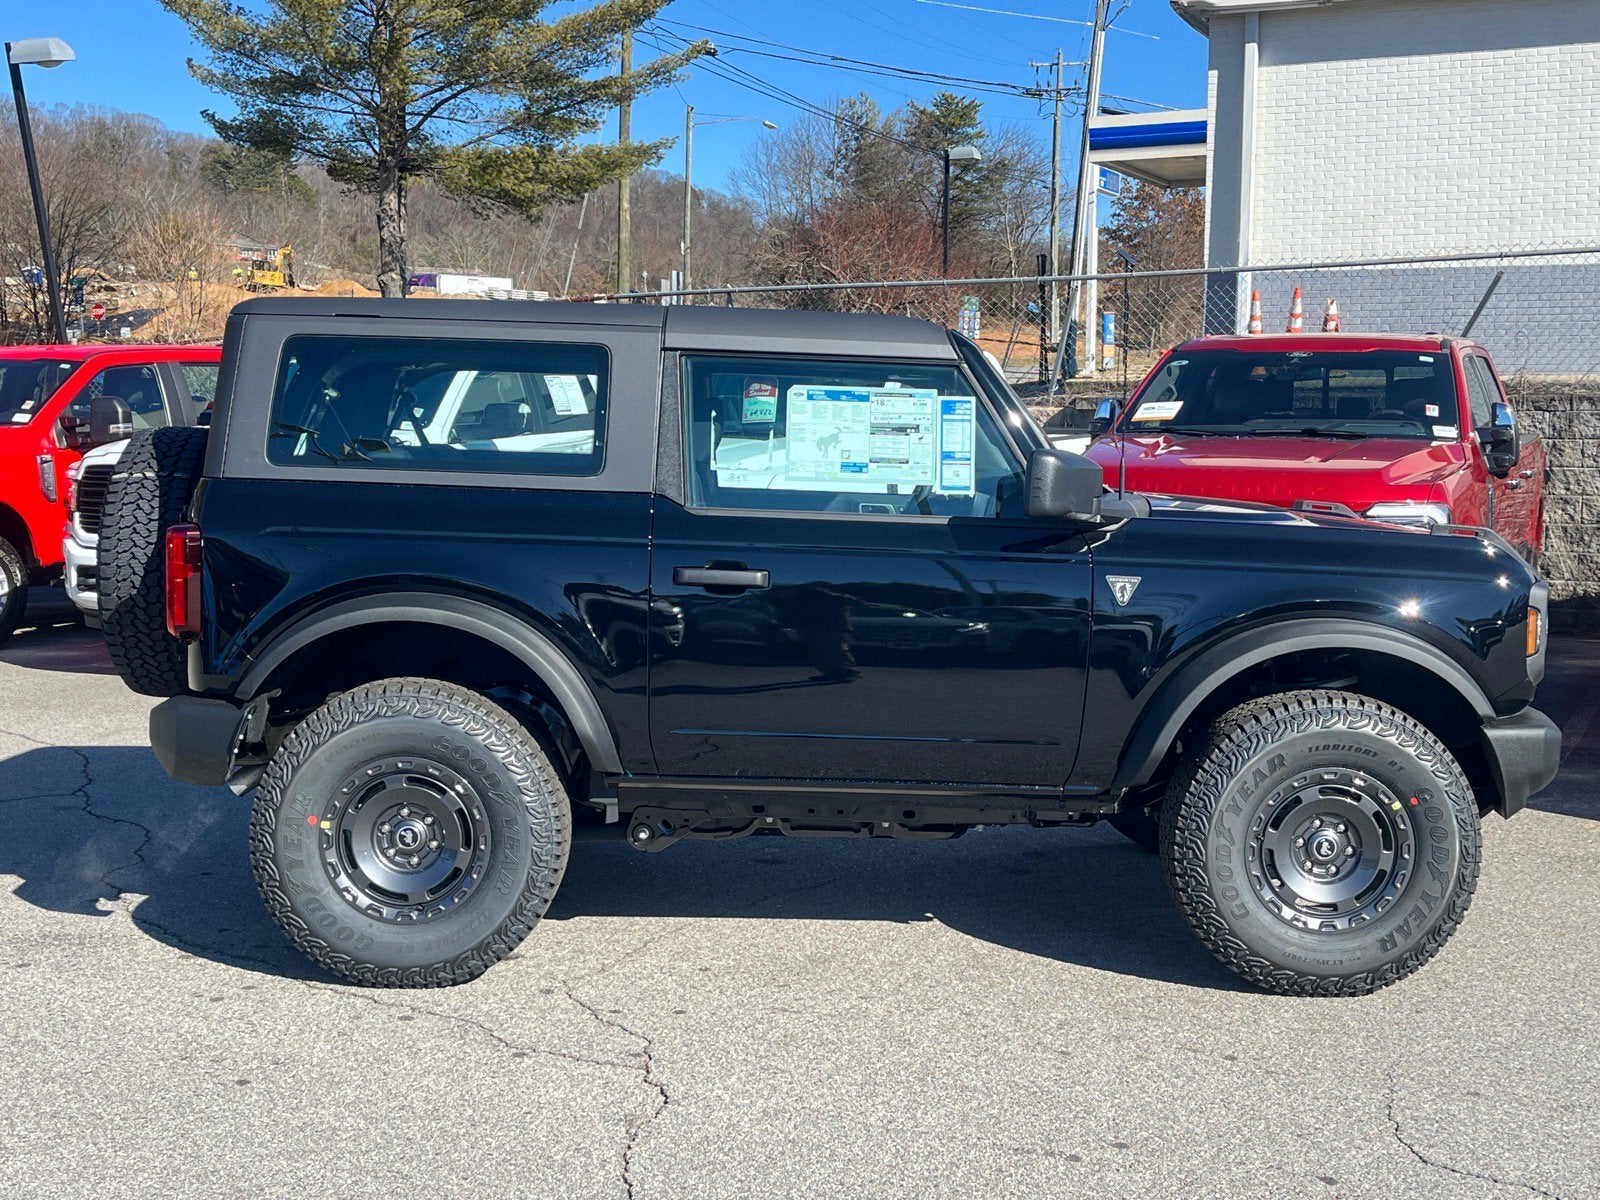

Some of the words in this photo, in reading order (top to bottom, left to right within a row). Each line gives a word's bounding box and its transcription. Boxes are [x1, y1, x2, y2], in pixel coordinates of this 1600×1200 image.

[1306, 743, 1380, 758] TERRITORY
[1215, 753, 1287, 921] GOODYEAR
[1376, 787, 1451, 955] GOODYEAR
